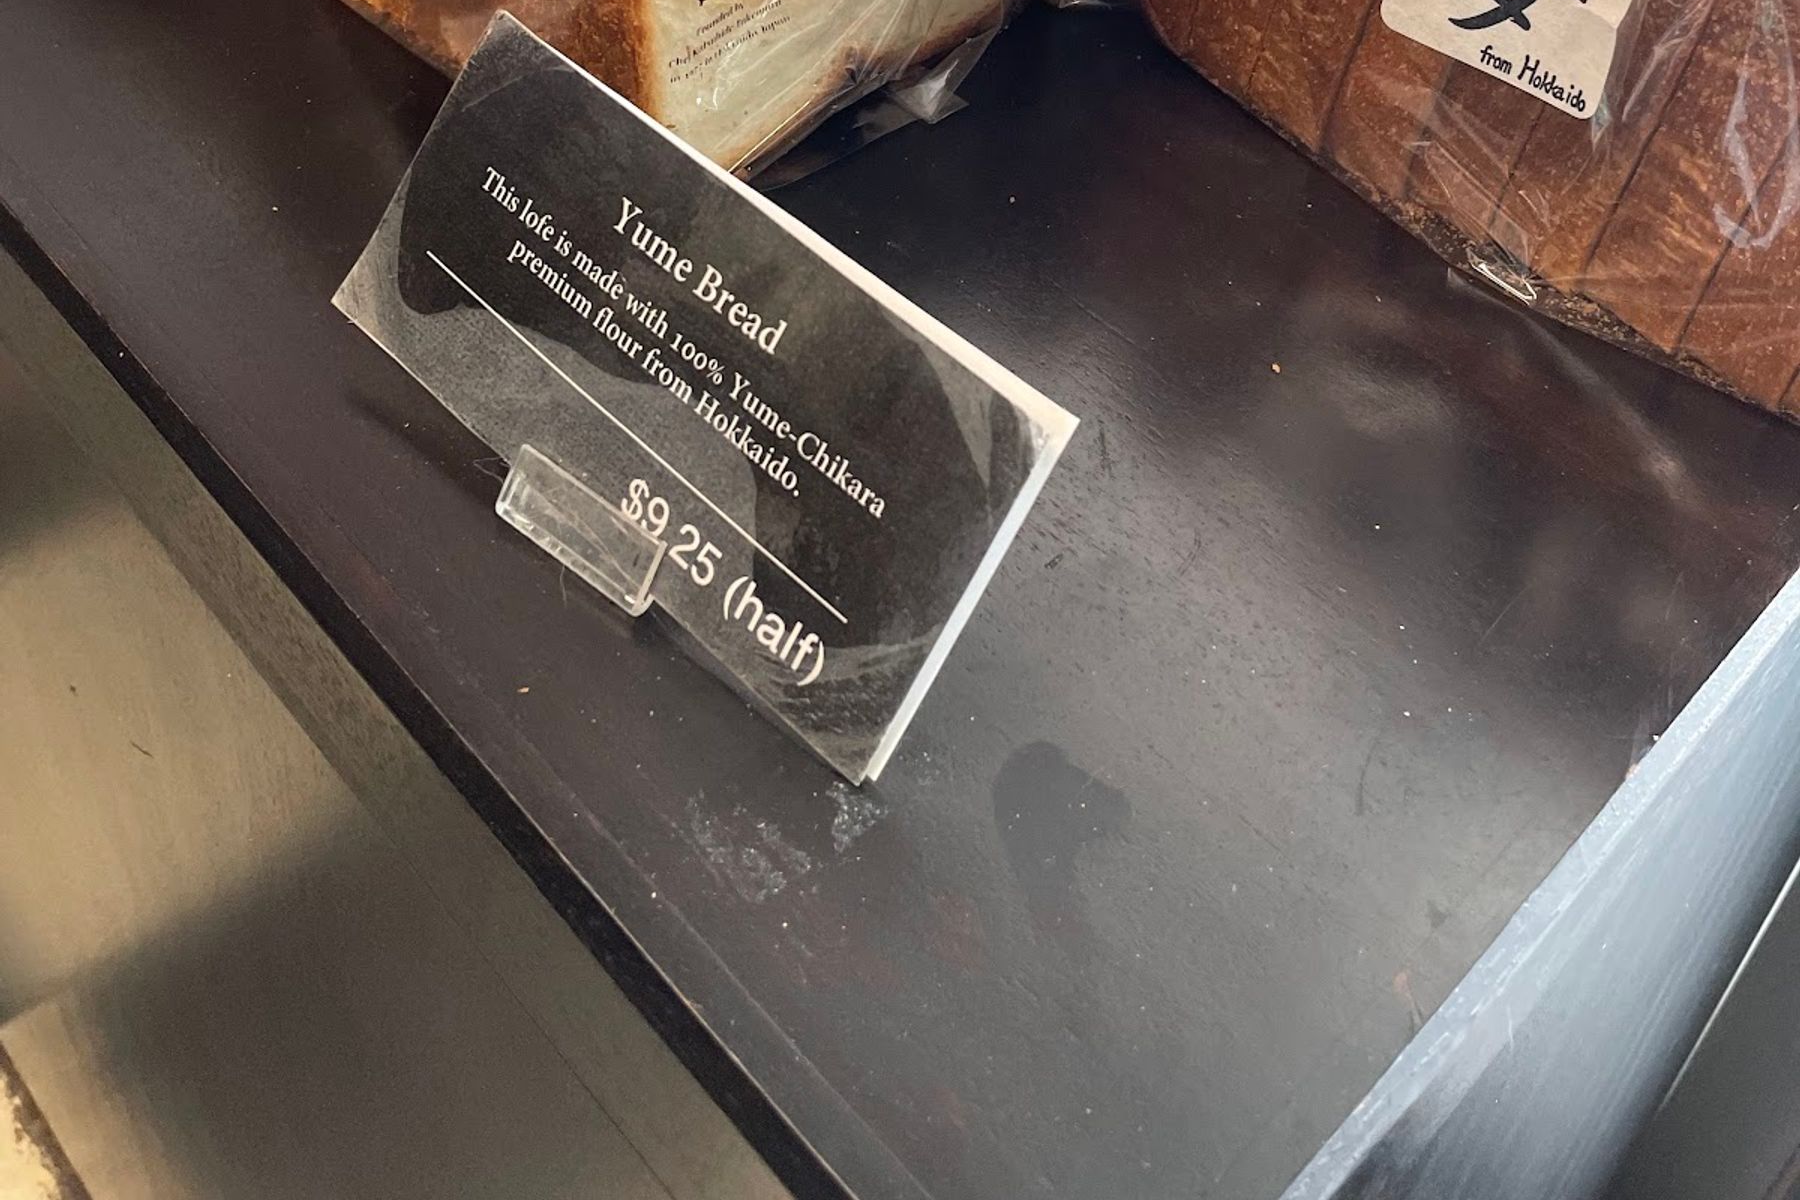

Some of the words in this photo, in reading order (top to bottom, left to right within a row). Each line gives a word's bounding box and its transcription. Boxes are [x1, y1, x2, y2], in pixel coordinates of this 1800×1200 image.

[1479, 45, 1514, 76] from
[1517, 54, 1587, 113] Hokkaido
[482, 166, 521, 214] This
[518, 199, 555, 242] lofe
[553, 230, 573, 257] is
[571, 249, 624, 300] made
[625, 292, 670, 339] with
[669, 333, 725, 386] 100%
[729, 371, 886, 519] Yume-Chikara
[507, 240, 593, 319] premium
[592, 307, 644, 359] flour
[641, 348, 693, 404] from
[694, 390, 800, 497] Hokkaido.
[613, 196, 693, 283] Yume
[692, 263, 788, 355] Bread
[620, 478, 723, 587] $925
[723, 575, 825, 687] (half)
